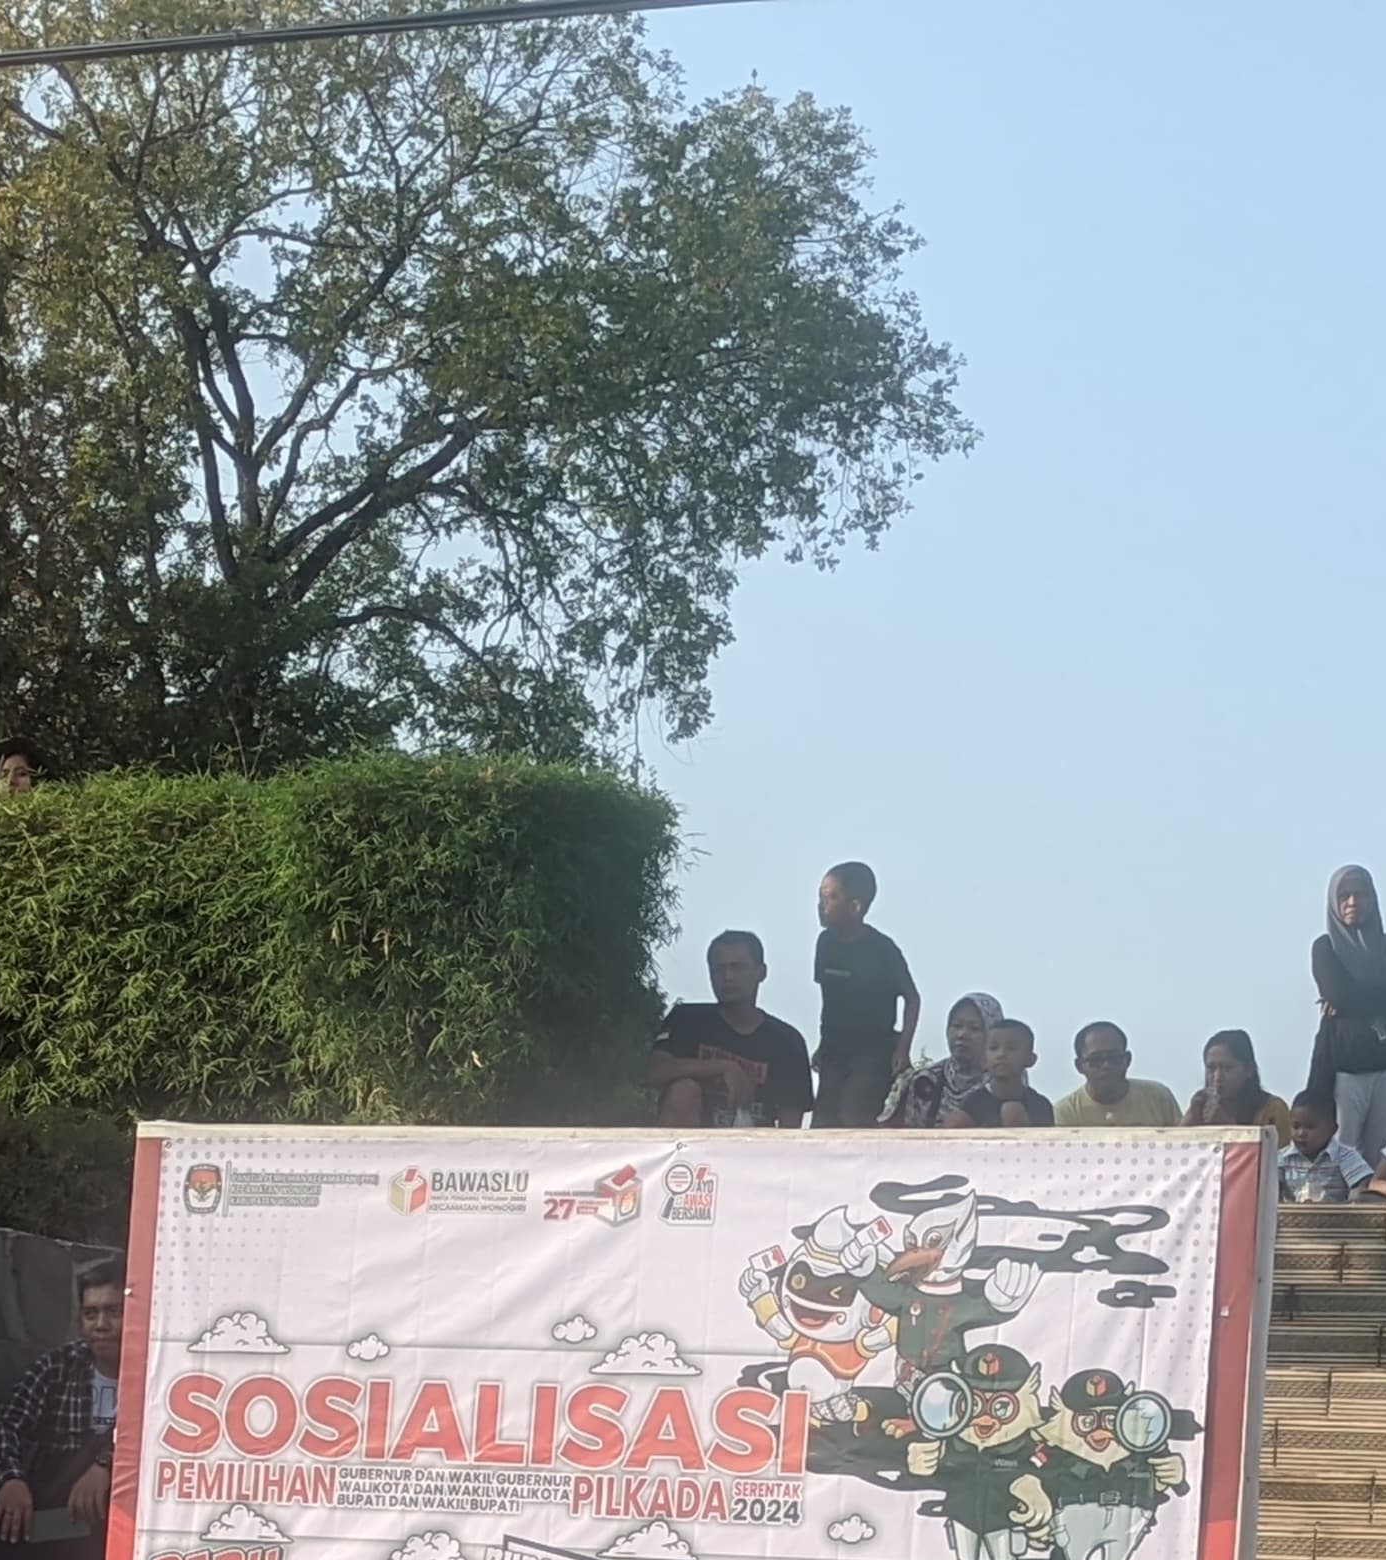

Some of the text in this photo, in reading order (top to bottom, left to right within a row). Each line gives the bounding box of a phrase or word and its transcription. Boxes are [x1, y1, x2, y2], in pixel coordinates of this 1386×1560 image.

[431, 1172, 529, 1193] BAWASLU
[544, 1198, 576, 1220] 27
[159, 1374, 810, 1475] SOSIALISASI
[156, 1461, 801, 1519] PEMILIHAN GUBERNUR DAN WAKIL GUBERNUR PILKADA SERENTAK
[339, 1480, 570, 1500] WALIKOTA DAN WAKIL WALIKOTA
[337, 1493, 801, 1524] BUPATI DAN WAKIL BUPATI 2024
